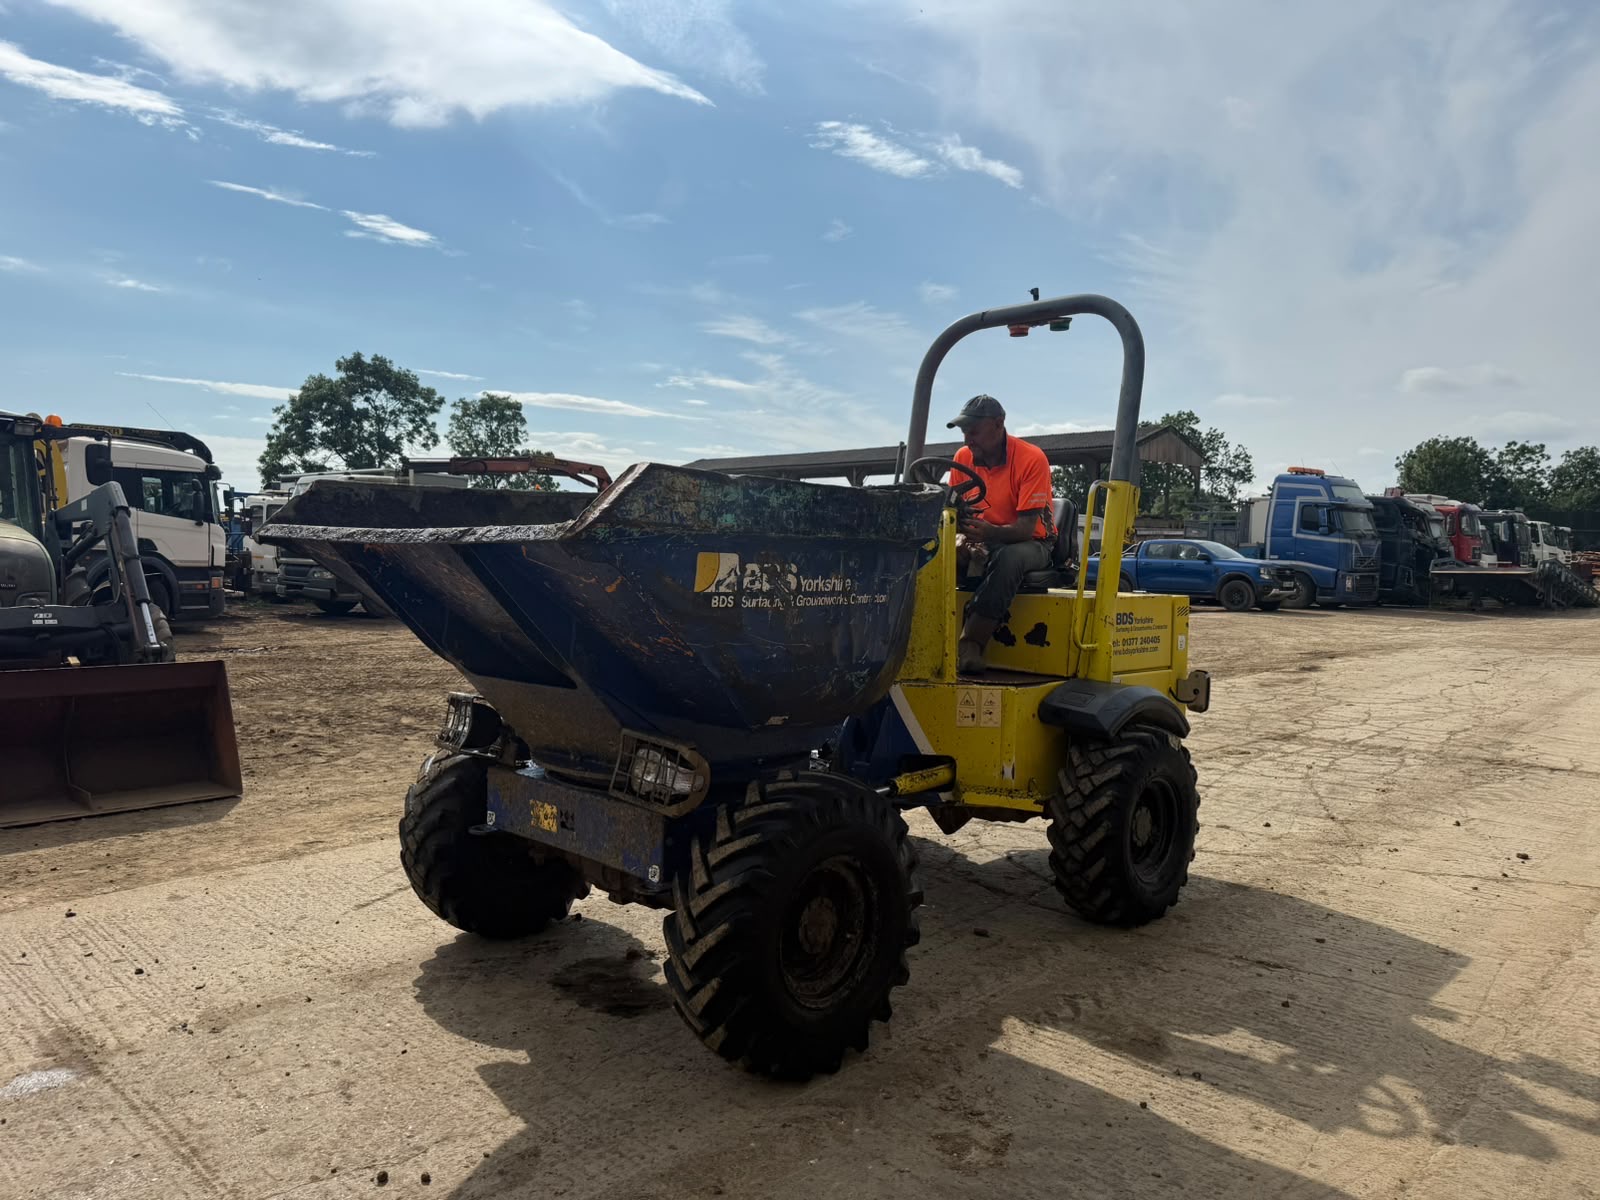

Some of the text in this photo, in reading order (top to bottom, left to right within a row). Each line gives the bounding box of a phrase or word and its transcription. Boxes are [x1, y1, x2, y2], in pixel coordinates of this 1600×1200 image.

[742, 563, 798, 592] BS
[711, 595, 734, 608] BDS
[1116, 612, 1134, 625] BDS
[1112, 639, 1120, 647] el:
[1122, 637, 1138, 647] 01377
[1113, 646, 1159, 656] ww.bdsyorkshire.com
